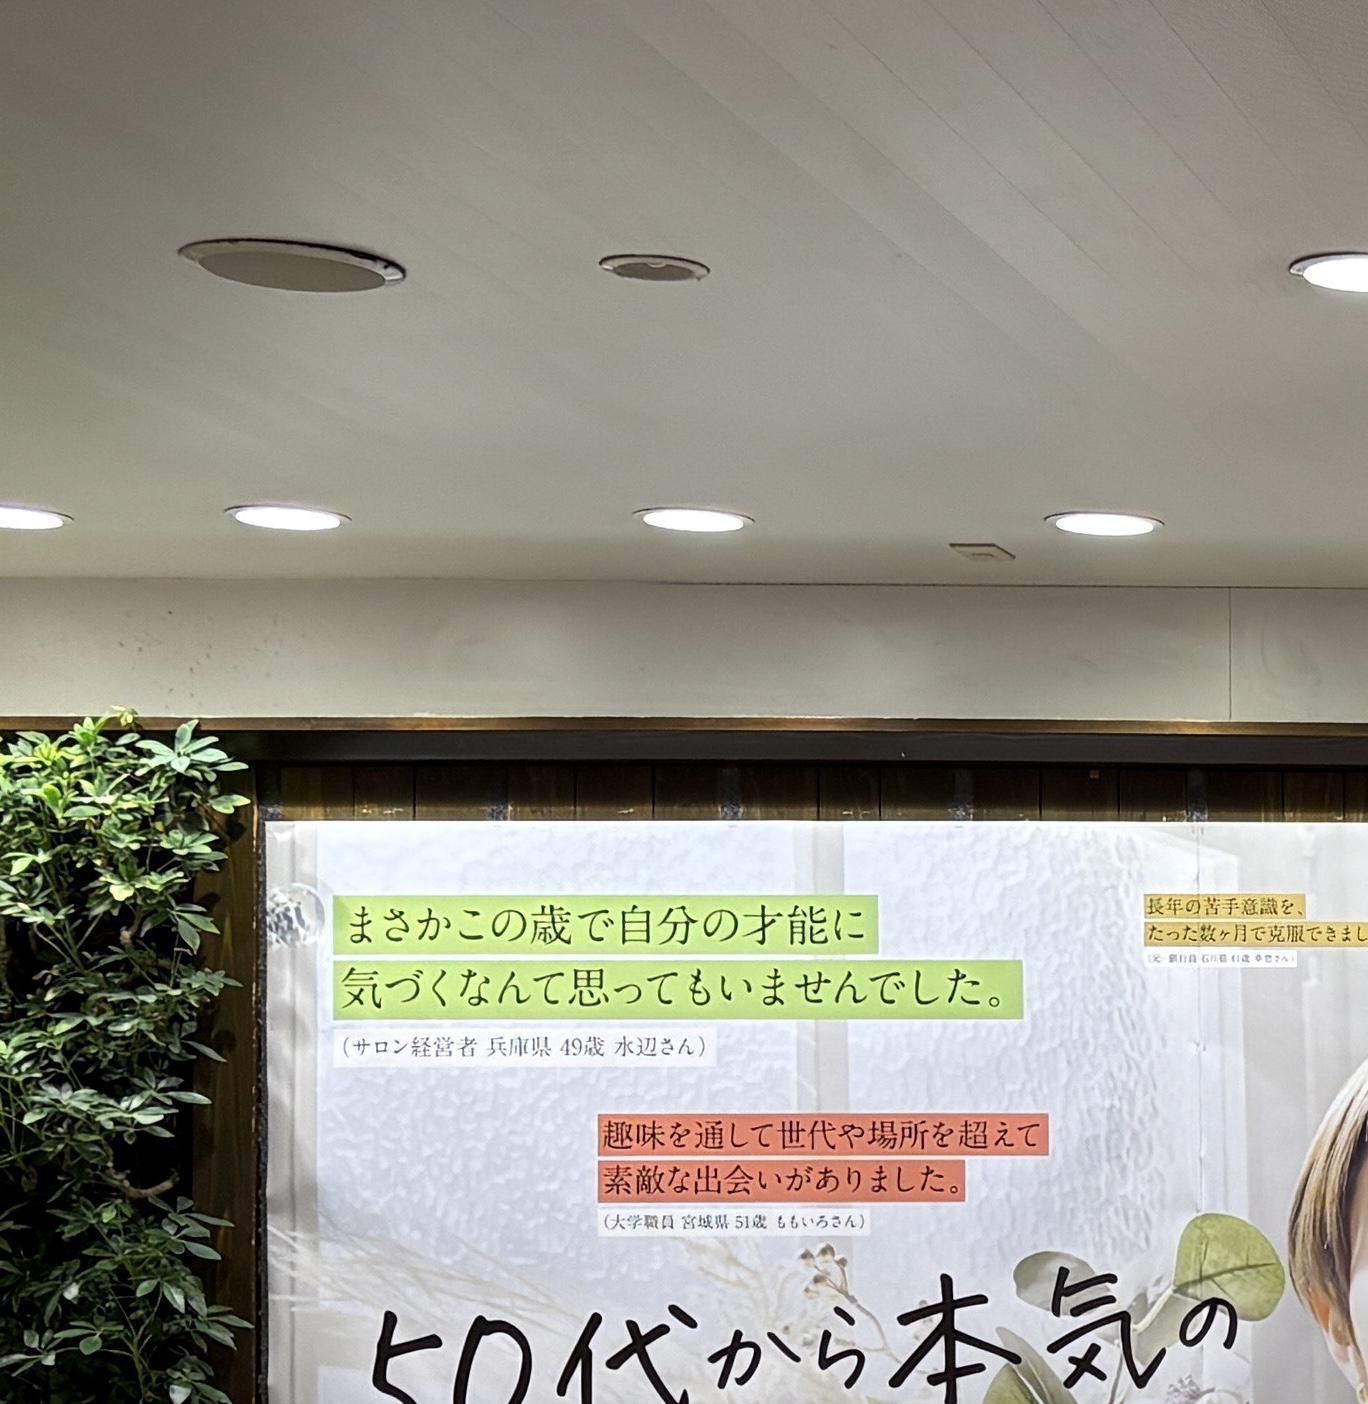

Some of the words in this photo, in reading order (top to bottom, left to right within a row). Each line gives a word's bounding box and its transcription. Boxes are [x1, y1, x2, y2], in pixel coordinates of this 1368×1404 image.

[1146, 898, 1304, 916] 長年の苦手意識を、
[345, 905, 866, 946] まさかこの歳で自分の才能に
[342, 967, 1004, 1010] 気づくなんて思ってもいませんでした。
[341, 1036, 476, 1059] （サロン経営者
[487, 1036, 551, 1059] 兵庫県
[560, 1037, 604, 1057] 49歳
[615, 1036, 707, 1059] 水辺さん）
[602, 1120, 1042, 1151] 趣味を通して世代や場所を超えて
[604, 1164, 961, 1195] 素敵な出会いがありました。
[682, 1213, 729, 1231] 宮城県
[735, 1214, 766, 1230] 51歳
